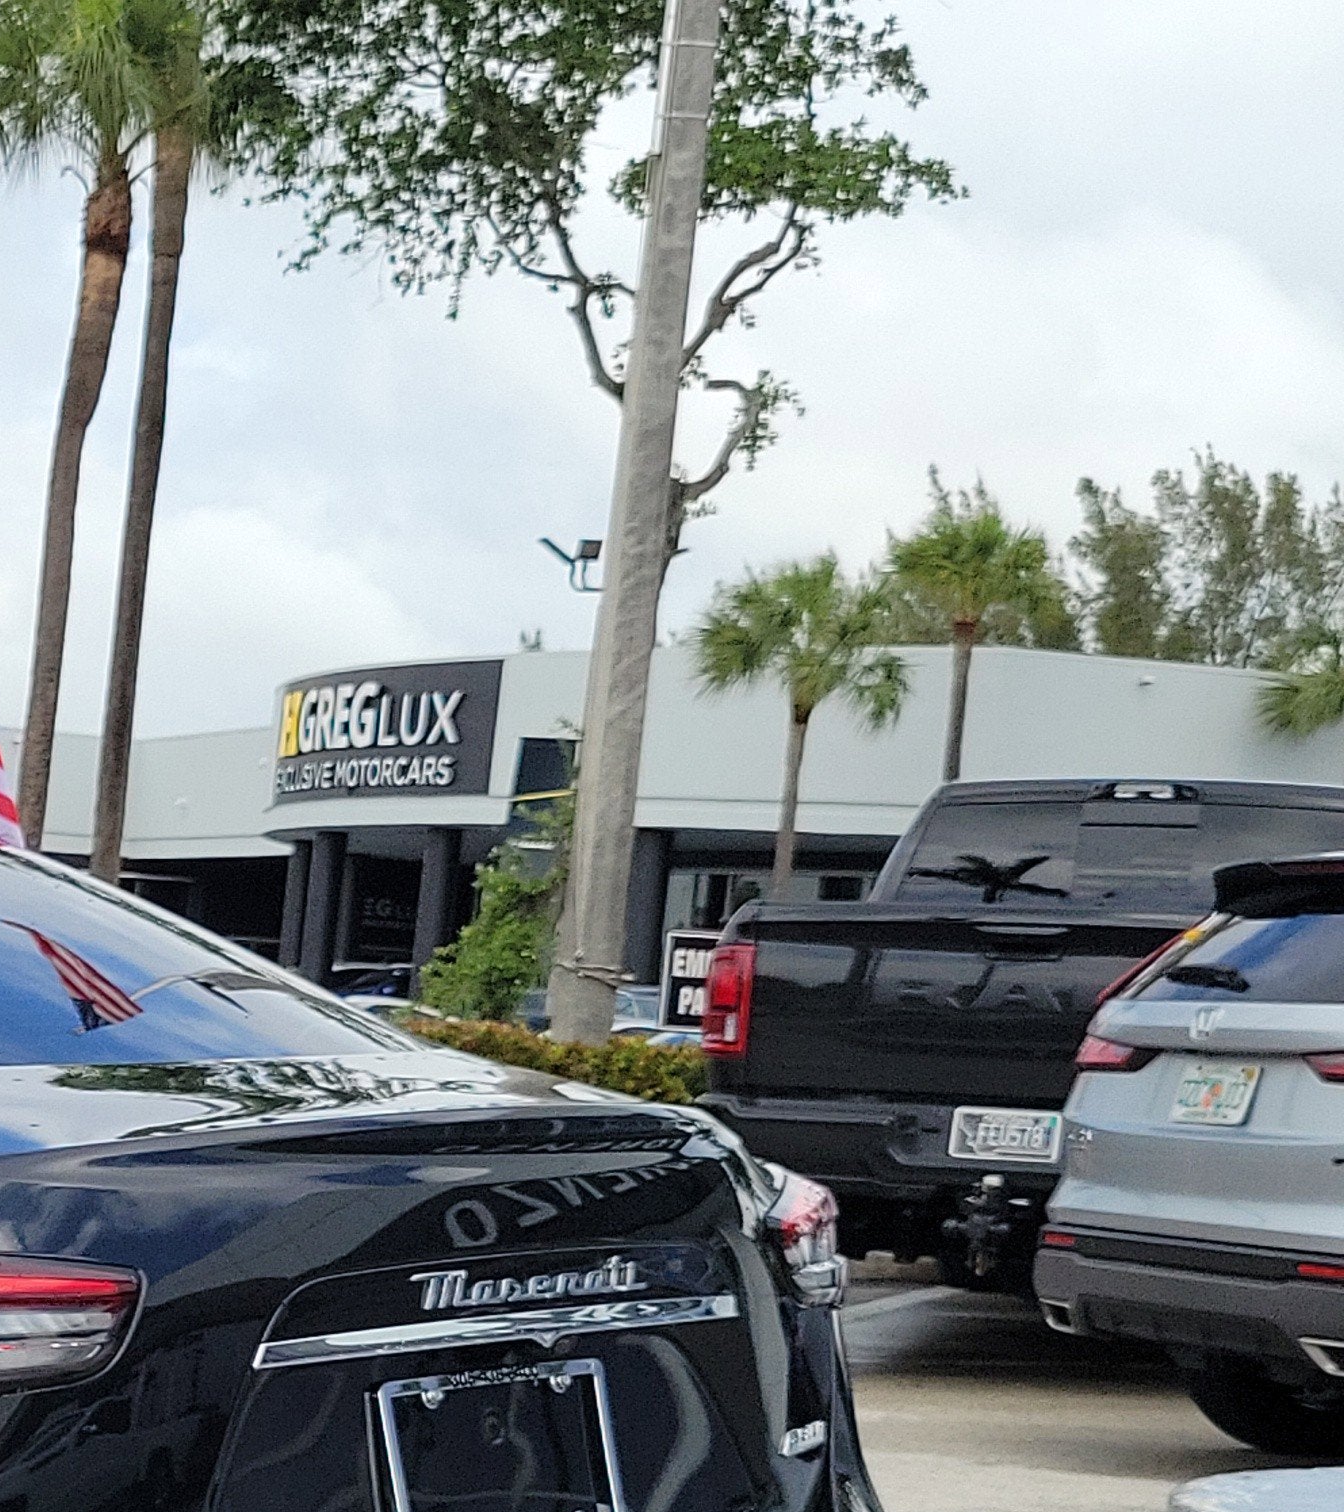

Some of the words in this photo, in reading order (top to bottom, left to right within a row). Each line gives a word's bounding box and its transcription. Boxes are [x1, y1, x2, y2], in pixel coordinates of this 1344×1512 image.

[376, 689, 464, 747] LUX
[333, 754, 458, 788] MOTORCARS
[410, 1255, 649, 1311] Maserati
